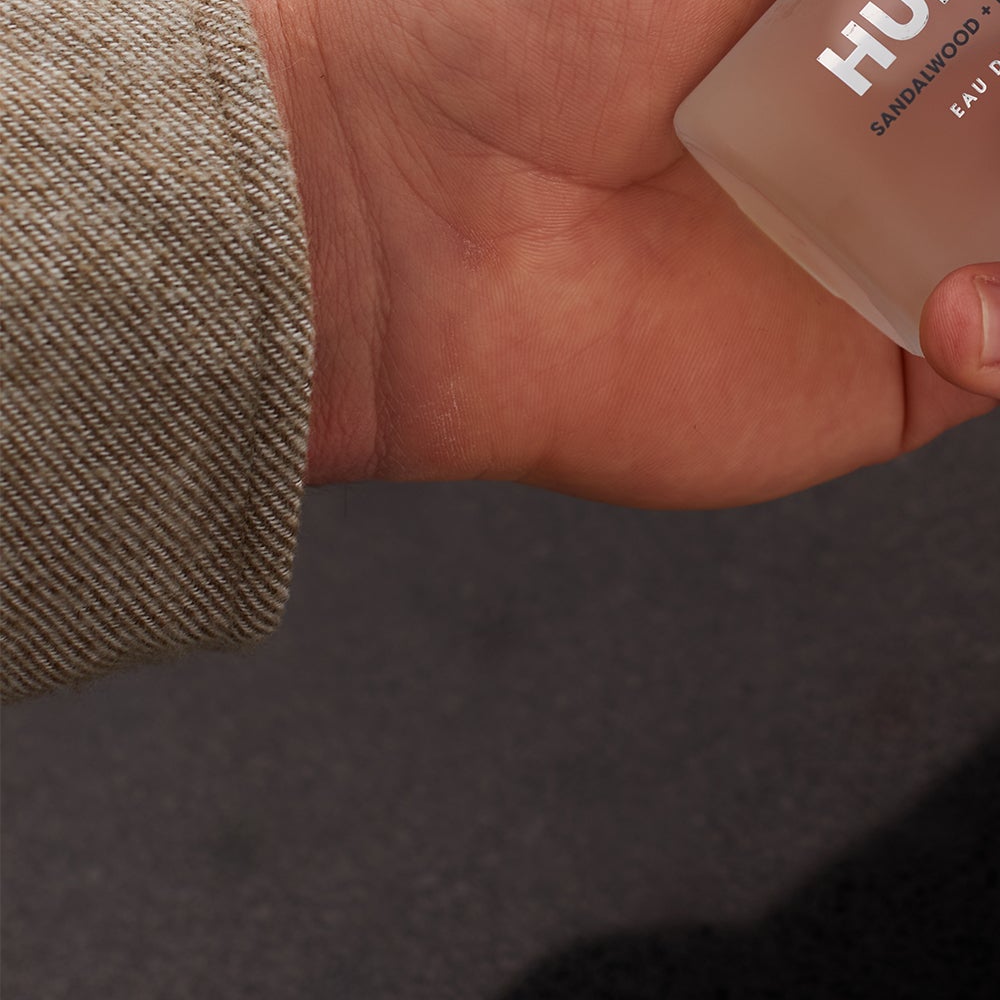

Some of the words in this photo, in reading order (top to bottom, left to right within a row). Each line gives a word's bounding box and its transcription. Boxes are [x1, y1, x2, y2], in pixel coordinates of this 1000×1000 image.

[870, 18, 980, 136] SANDALWOOD
[981, 5, 991, 16] +
[949, 77, 988, 118] EAU
